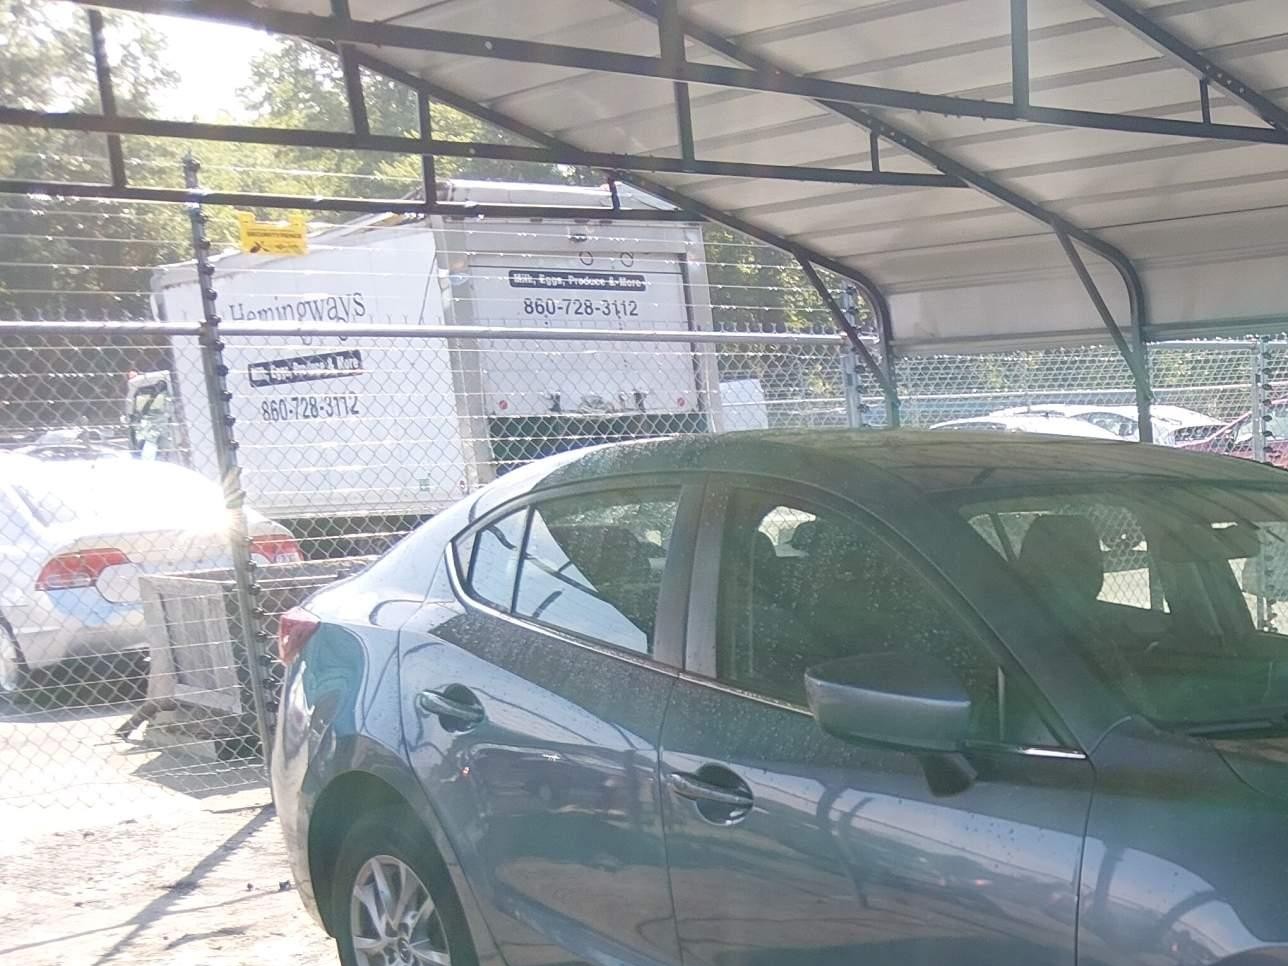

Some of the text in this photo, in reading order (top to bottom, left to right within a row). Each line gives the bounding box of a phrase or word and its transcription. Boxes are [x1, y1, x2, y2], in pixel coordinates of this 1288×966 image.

[569, 275, 605, 286] Produce
[619, 277, 642, 287] More
[523, 298, 639, 316] 860-728-3112
[229, 292, 366, 345] Hemingways
